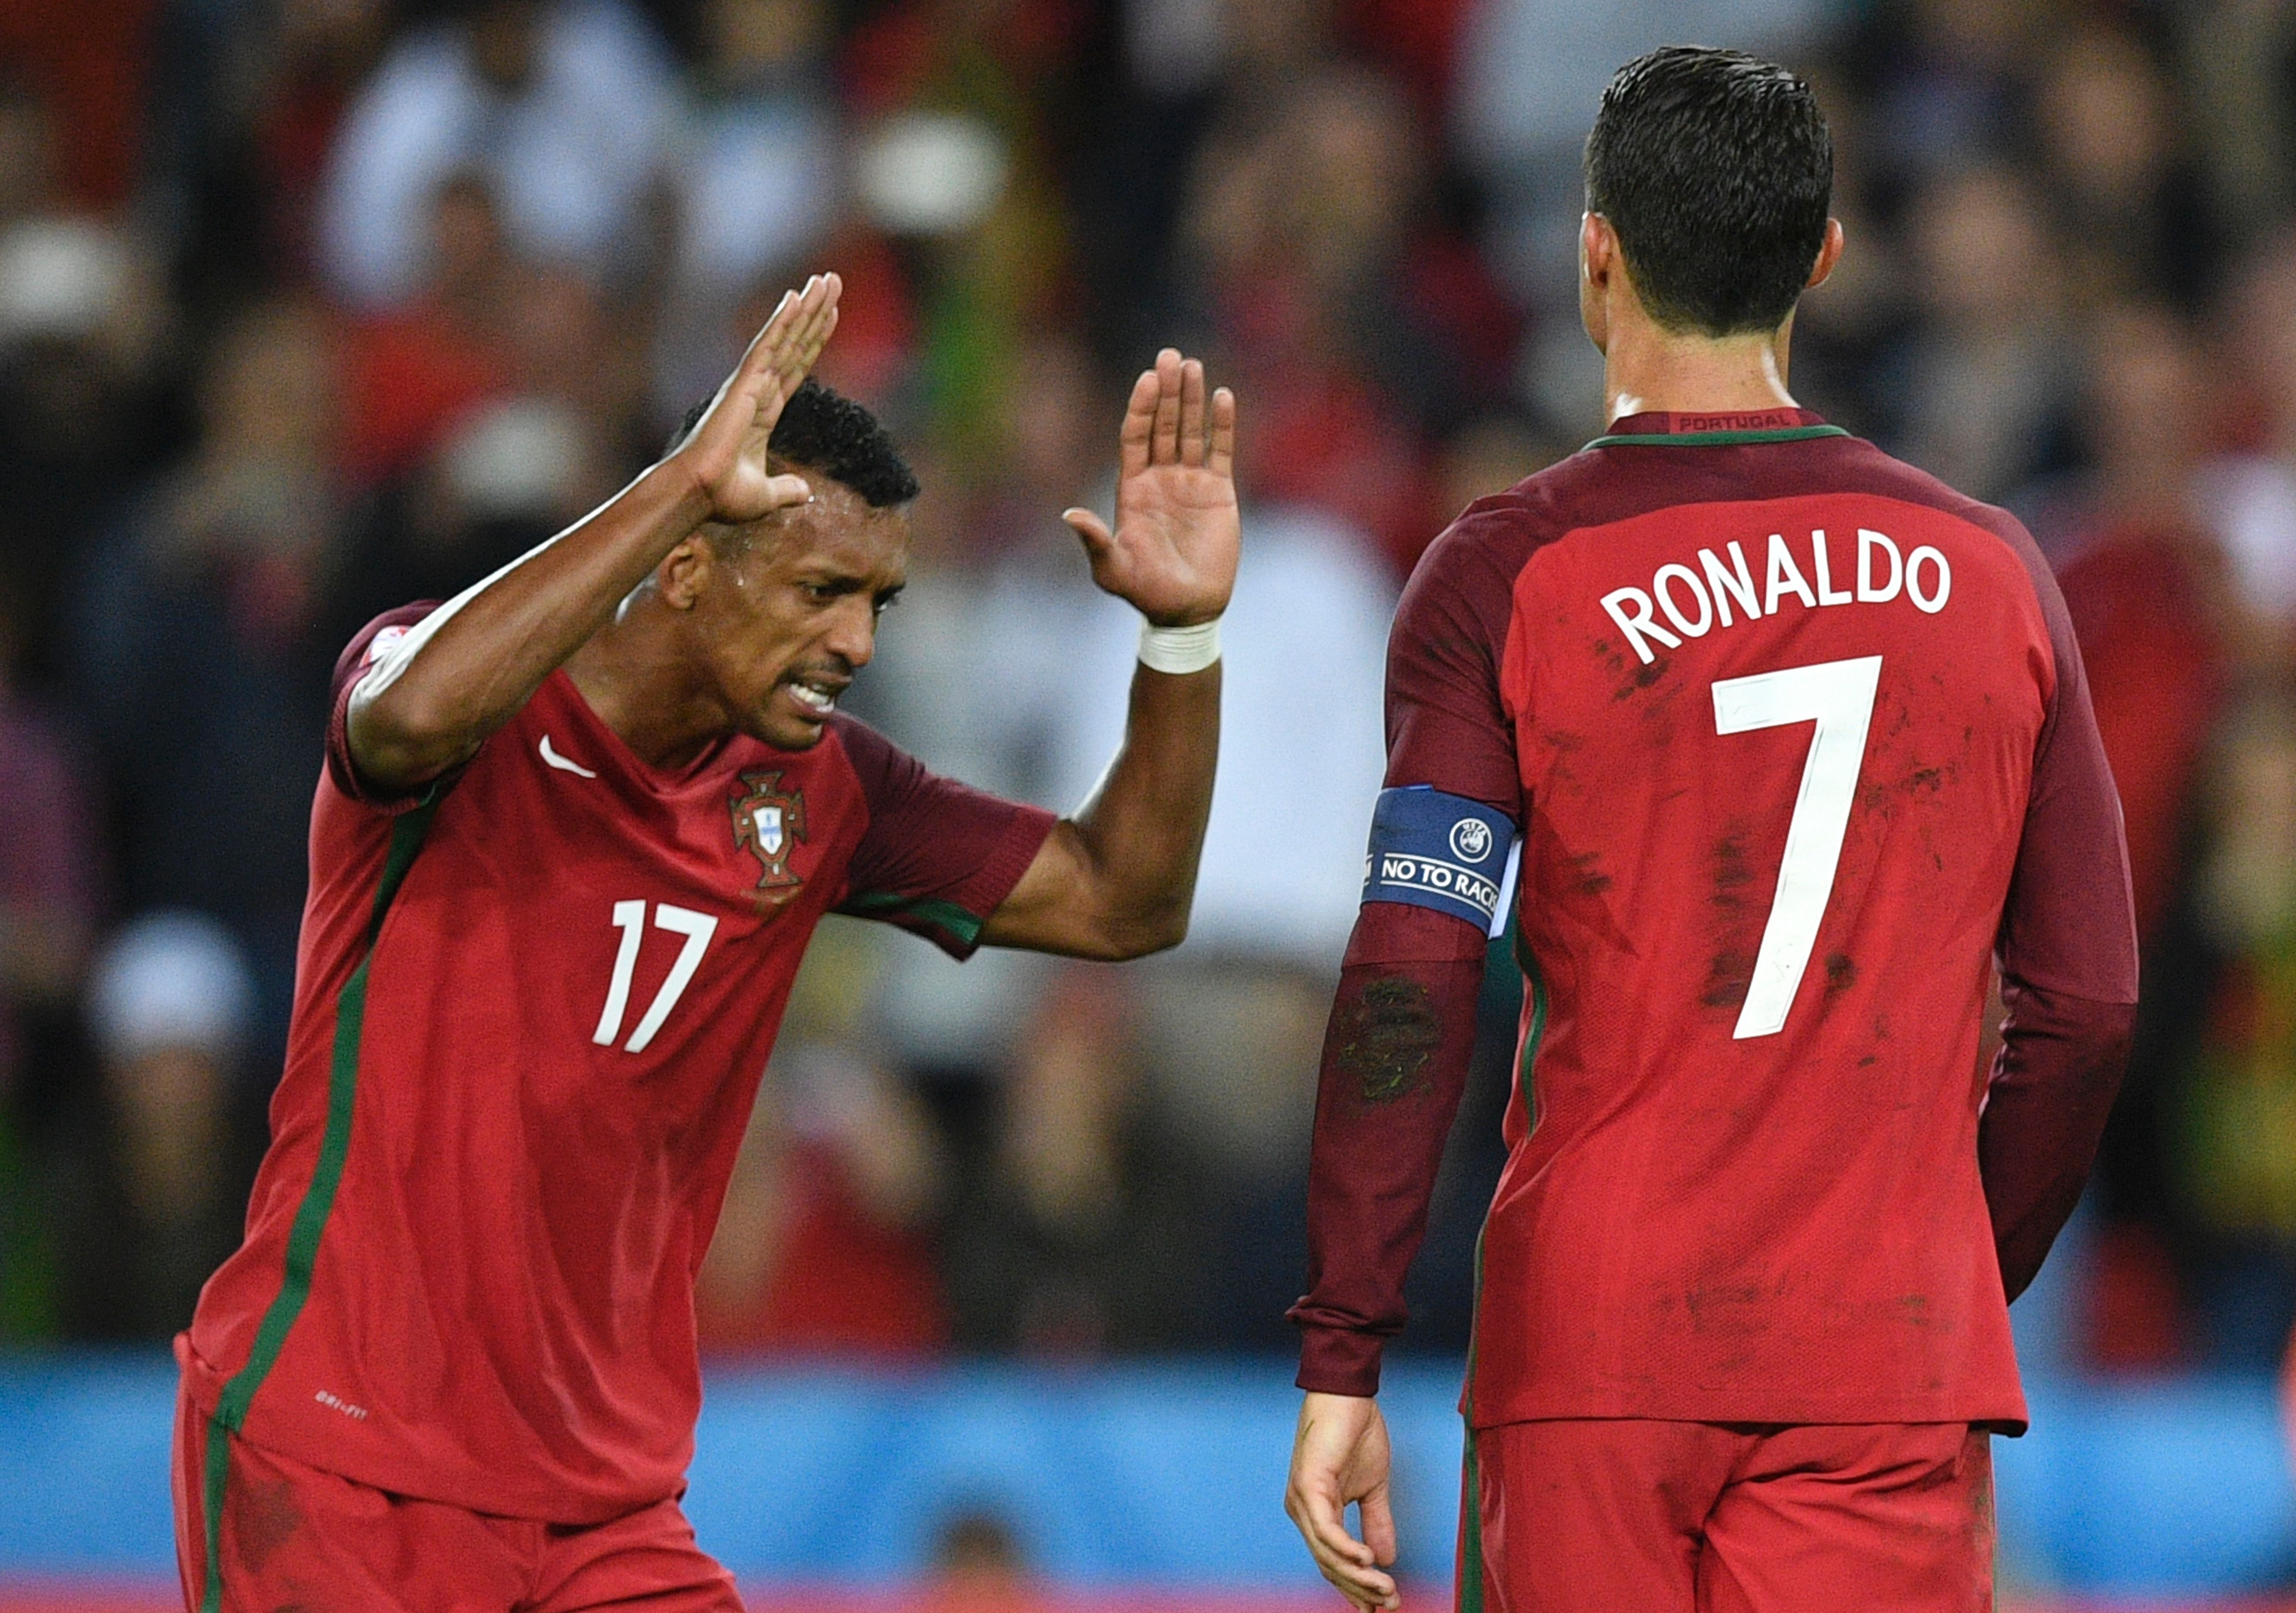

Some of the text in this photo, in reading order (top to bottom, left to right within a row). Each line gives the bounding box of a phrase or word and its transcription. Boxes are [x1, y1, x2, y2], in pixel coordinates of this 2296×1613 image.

[1679, 415, 1790, 432] PORTUGAL
[1600, 529, 1951, 665] RONALDO
[1382, 859, 1416, 879] NO
[1421, 864, 1451, 887] TO
[1711, 655, 1883, 1039] 7
[592, 899, 719, 1053] 17
